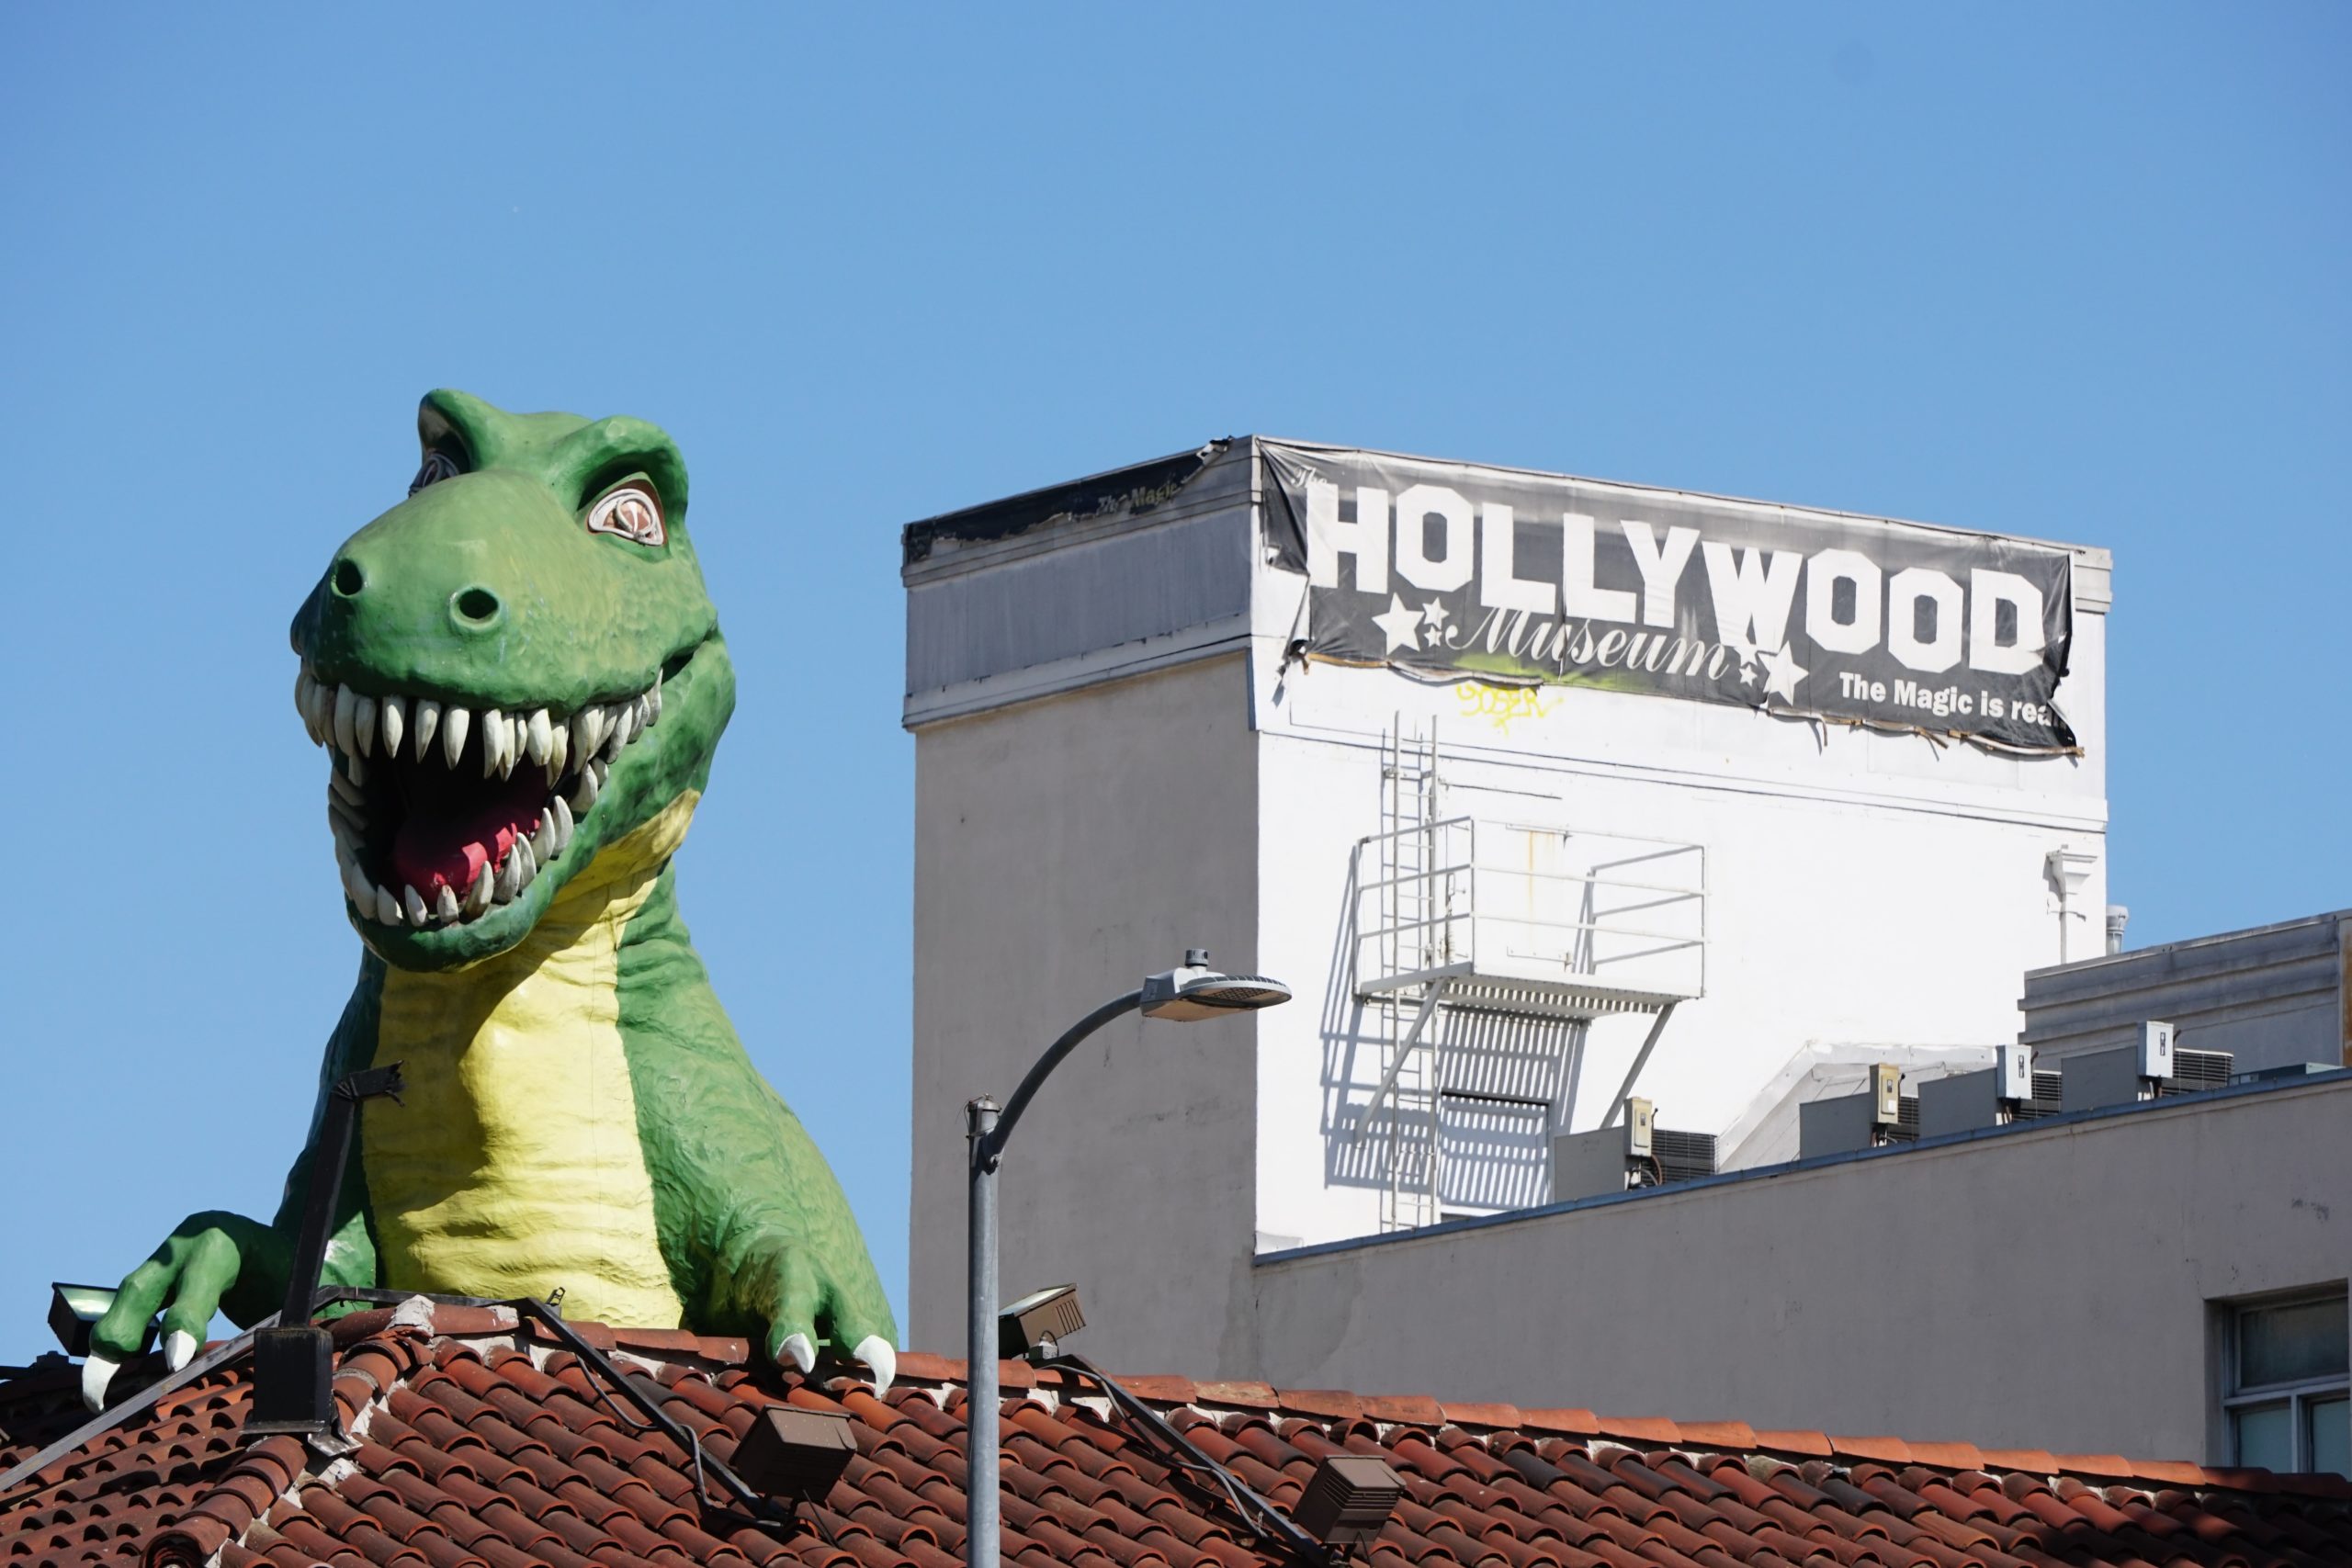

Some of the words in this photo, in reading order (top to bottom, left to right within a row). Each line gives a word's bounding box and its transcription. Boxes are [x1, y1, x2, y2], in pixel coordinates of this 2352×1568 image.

[1096, 494, 1128, 517] Th
[1306, 483, 2046, 676] HOLLYWOOD
[1445, 606, 1729, 681] Museum
[1838, 671, 1887, 704] The
[1894, 678, 1973, 717] Magic
[1980, 690, 2005, 718] is
